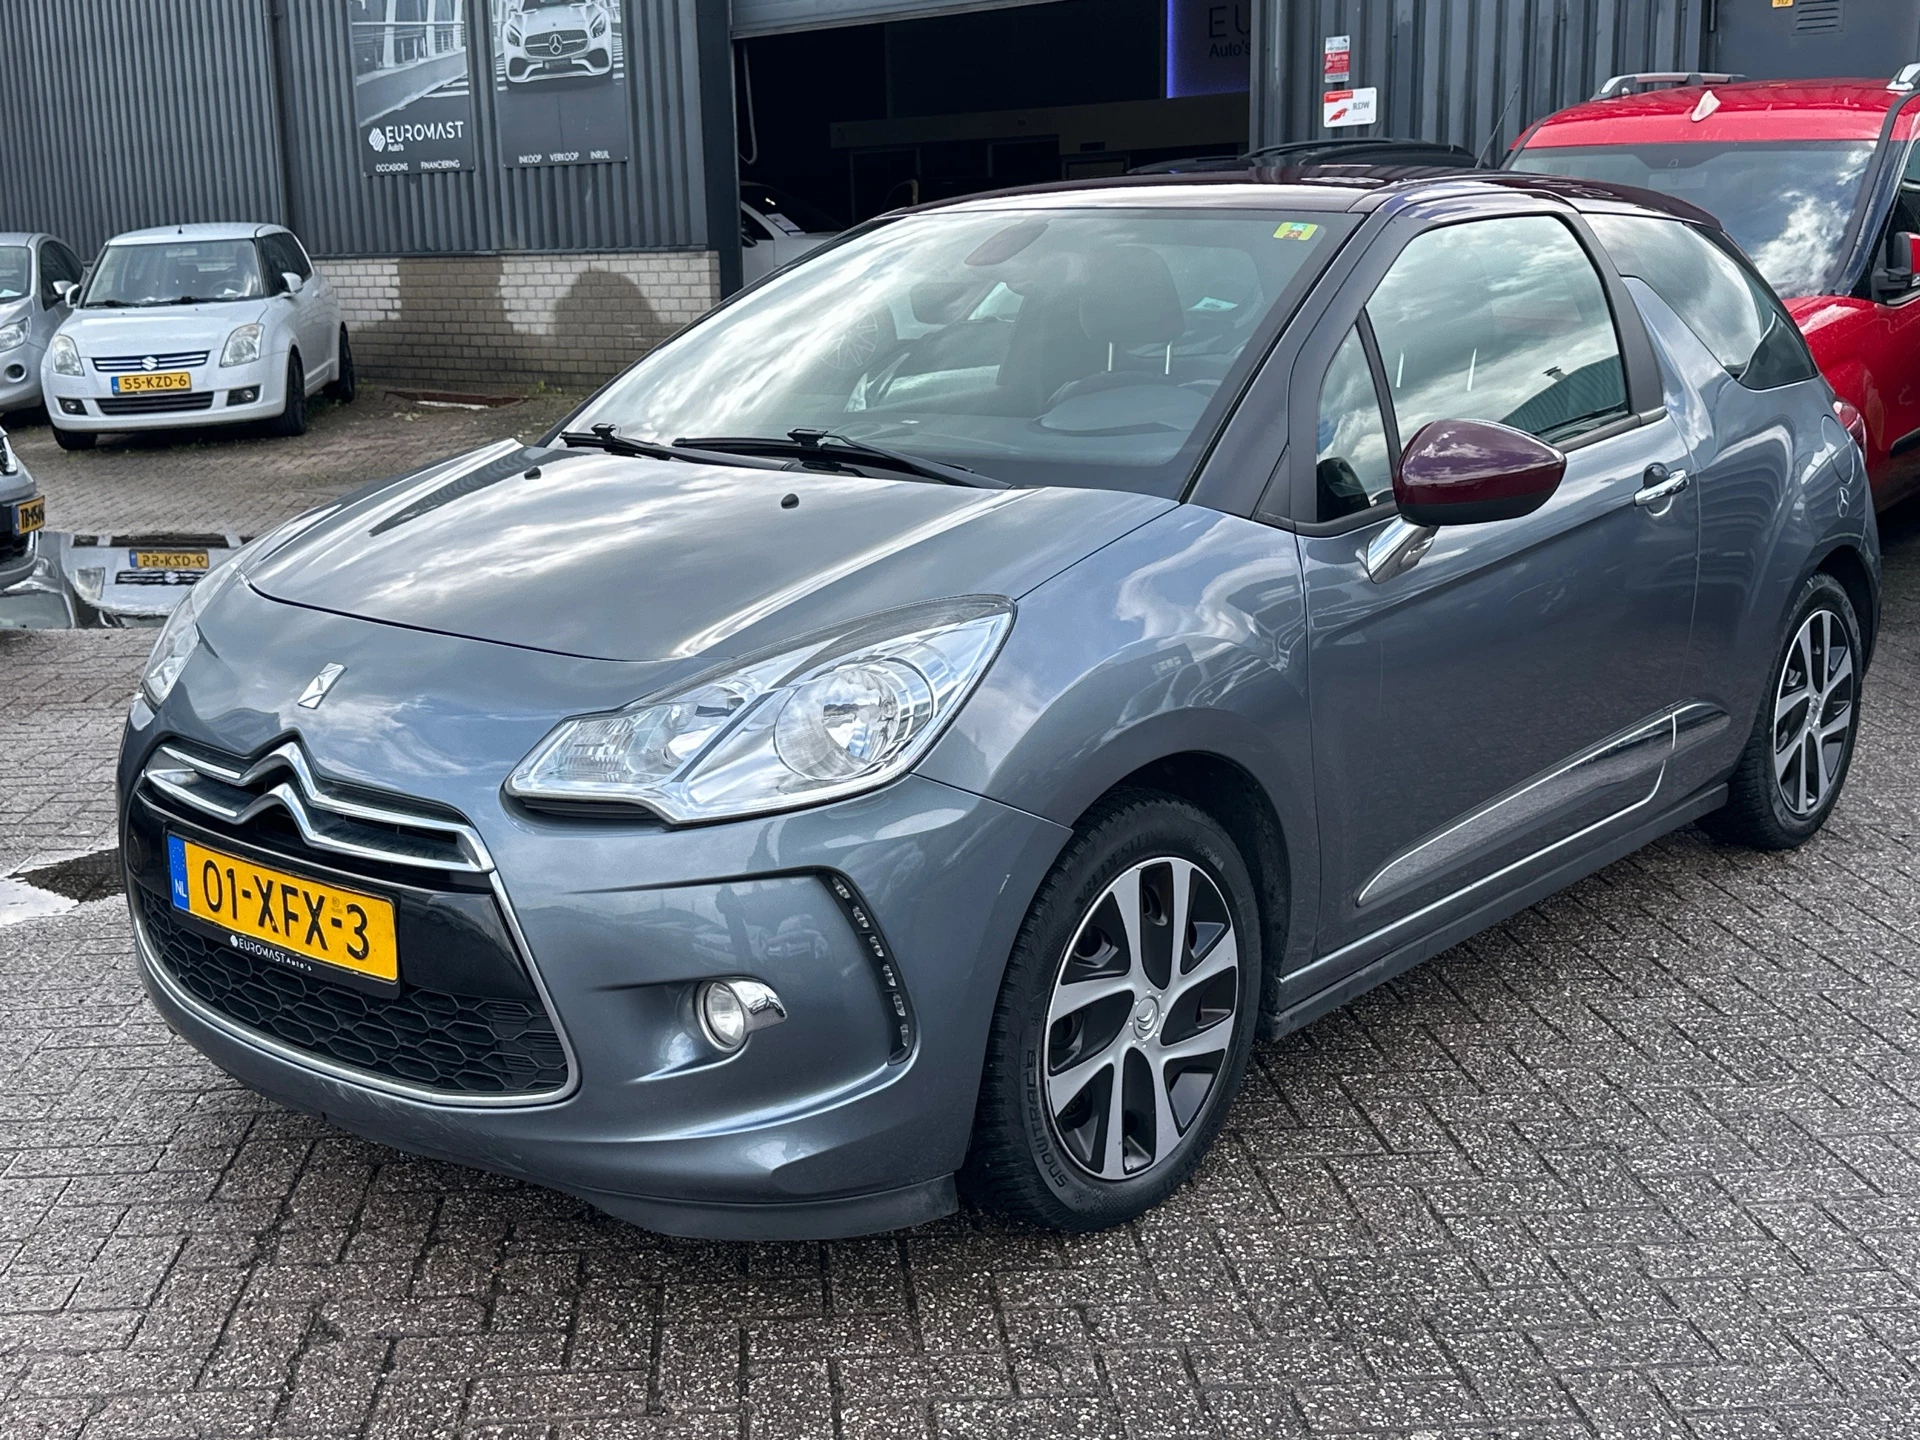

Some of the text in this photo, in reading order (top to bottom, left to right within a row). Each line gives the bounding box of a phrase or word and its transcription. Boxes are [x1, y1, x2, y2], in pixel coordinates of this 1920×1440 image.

[1352, 101, 1370, 111] RDW
[385, 121, 464, 143] EUROMAST
[387, 143, 404, 152] Auto's
[518, 154, 543, 164] INKOOP
[549, 151, 580, 162] VERKOOP
[375, 162, 409, 173] OCCASIONS
[124, 375, 187, 390] 55-KZD-6
[174, 877, 187, 899] NL
[202, 859, 370, 961] 01-XFX-3
[238, 938, 312, 972] EUROMAST Auto's
